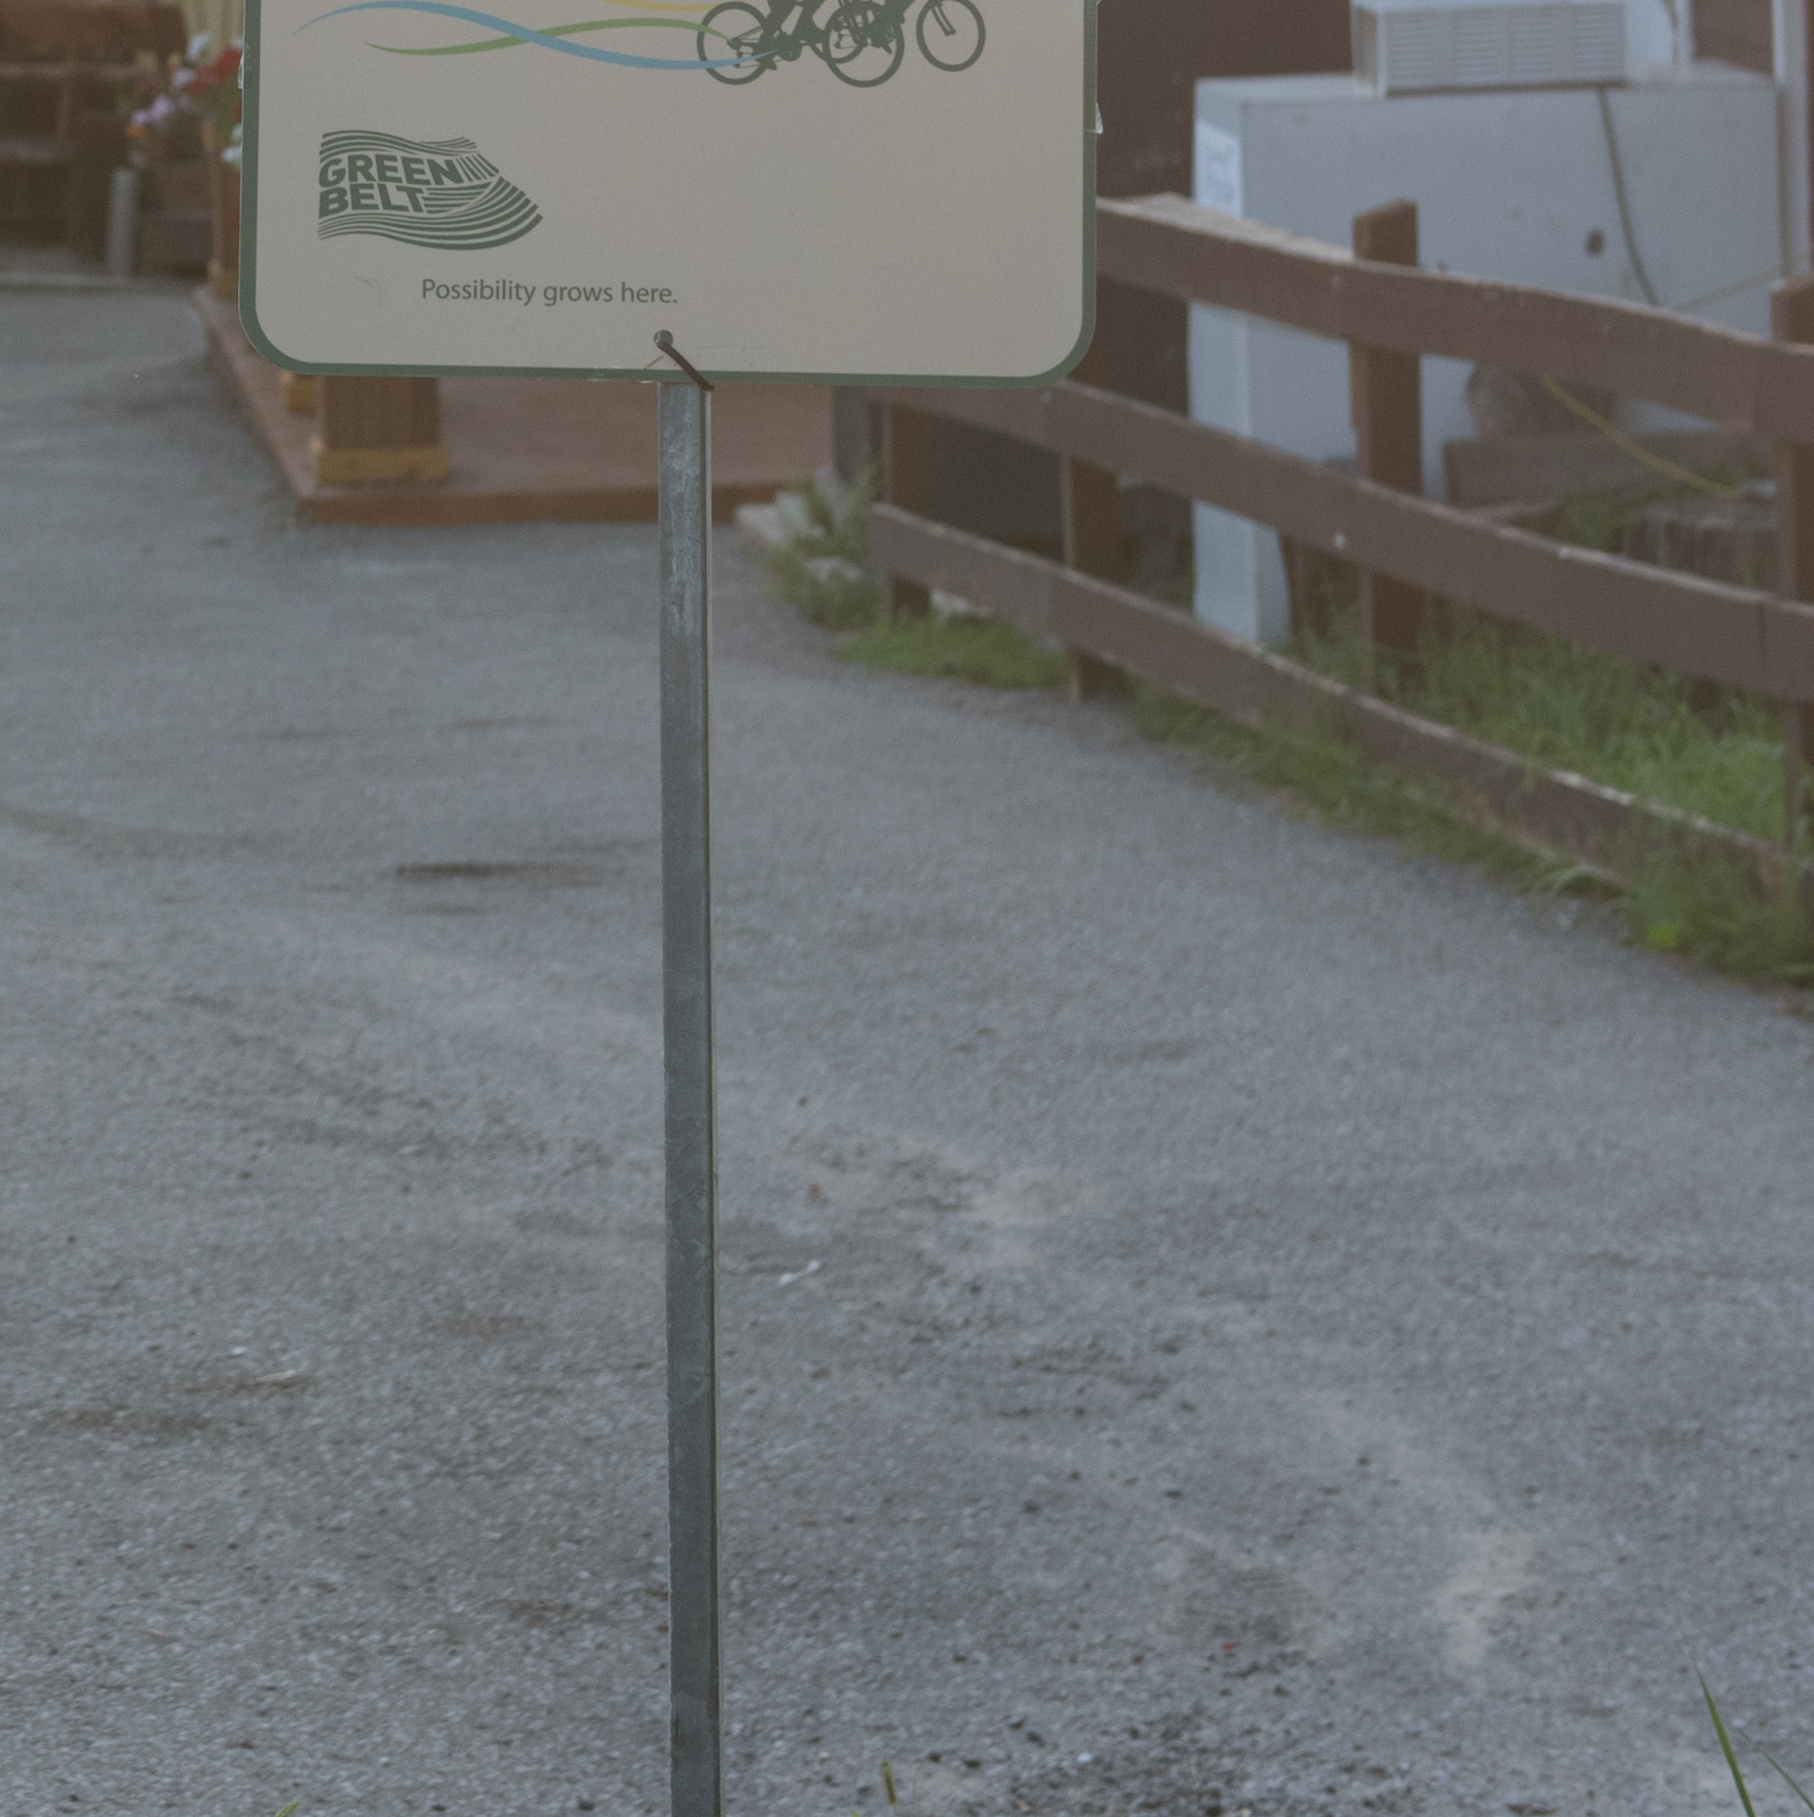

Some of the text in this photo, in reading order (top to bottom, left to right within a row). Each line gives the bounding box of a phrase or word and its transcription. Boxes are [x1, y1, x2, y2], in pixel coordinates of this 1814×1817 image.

[318, 153, 465, 187] GREEN
[318, 183, 424, 219] BELT
[421, 278, 679, 308] Possibility grows here.
